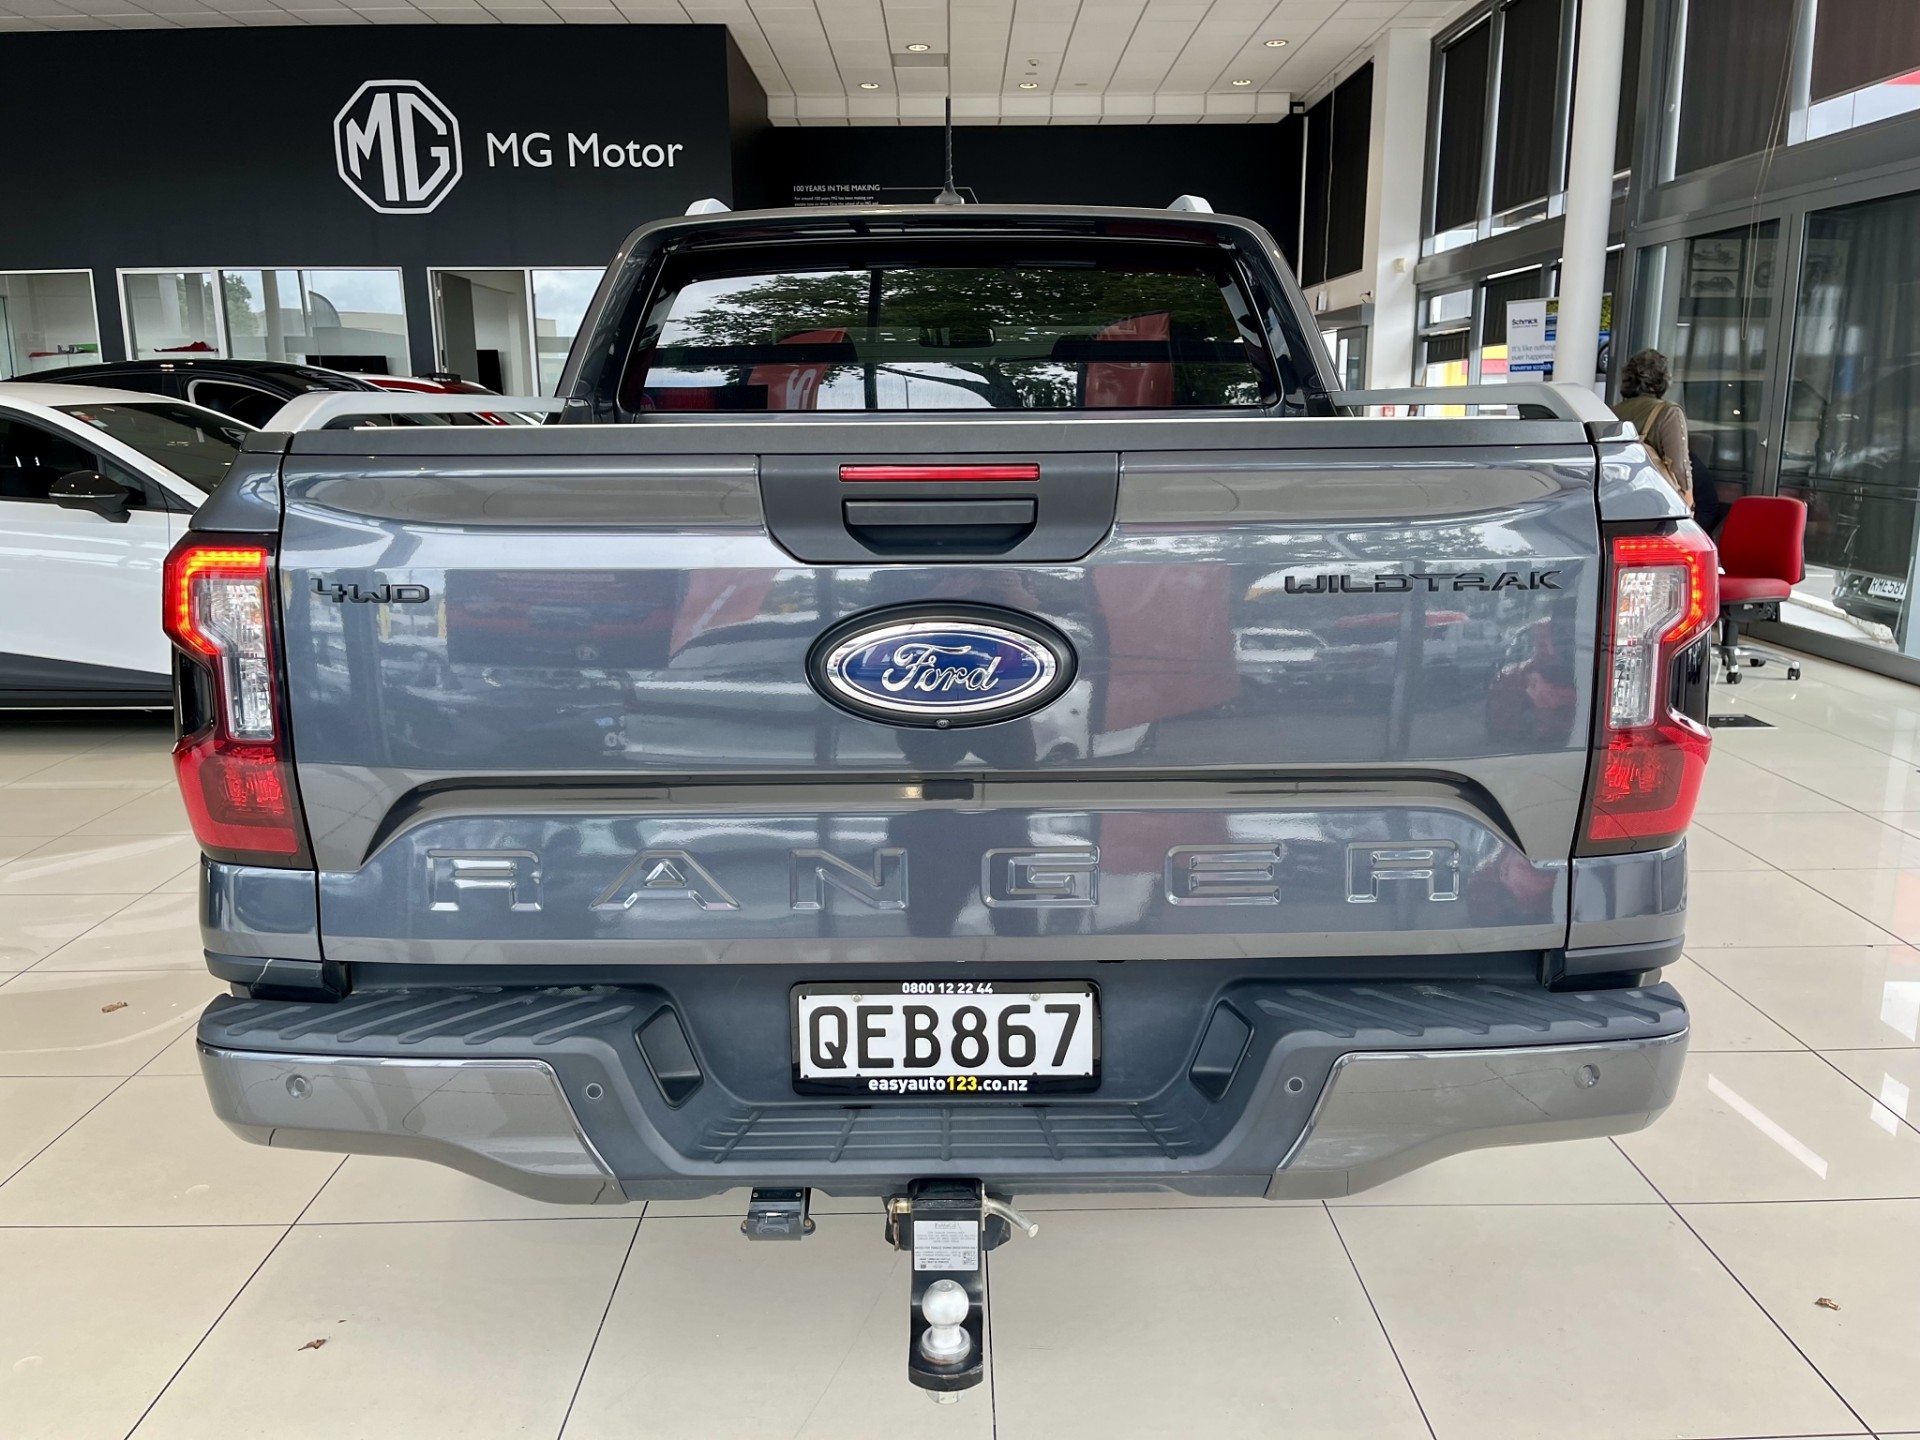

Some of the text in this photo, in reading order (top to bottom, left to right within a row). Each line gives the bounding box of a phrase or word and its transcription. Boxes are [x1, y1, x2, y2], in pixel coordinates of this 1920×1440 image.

[345, 91, 451, 202] MG
[485, 132, 684, 168] MG Motor
[836, 184, 850, 192] THE
[1533, 344, 1556, 352] nothing
[310, 577, 430, 603] 4WD
[1284, 570, 1563, 595] WILDTRAK
[880, 643, 1002, 693] Ford
[426, 840, 1461, 912] RANGER
[901, 982, 994, 995] 0800 12 22 44
[808, 1003, 1082, 1070] QEB867
[867, 1076, 1028, 1094] easyauto123.co.nz
